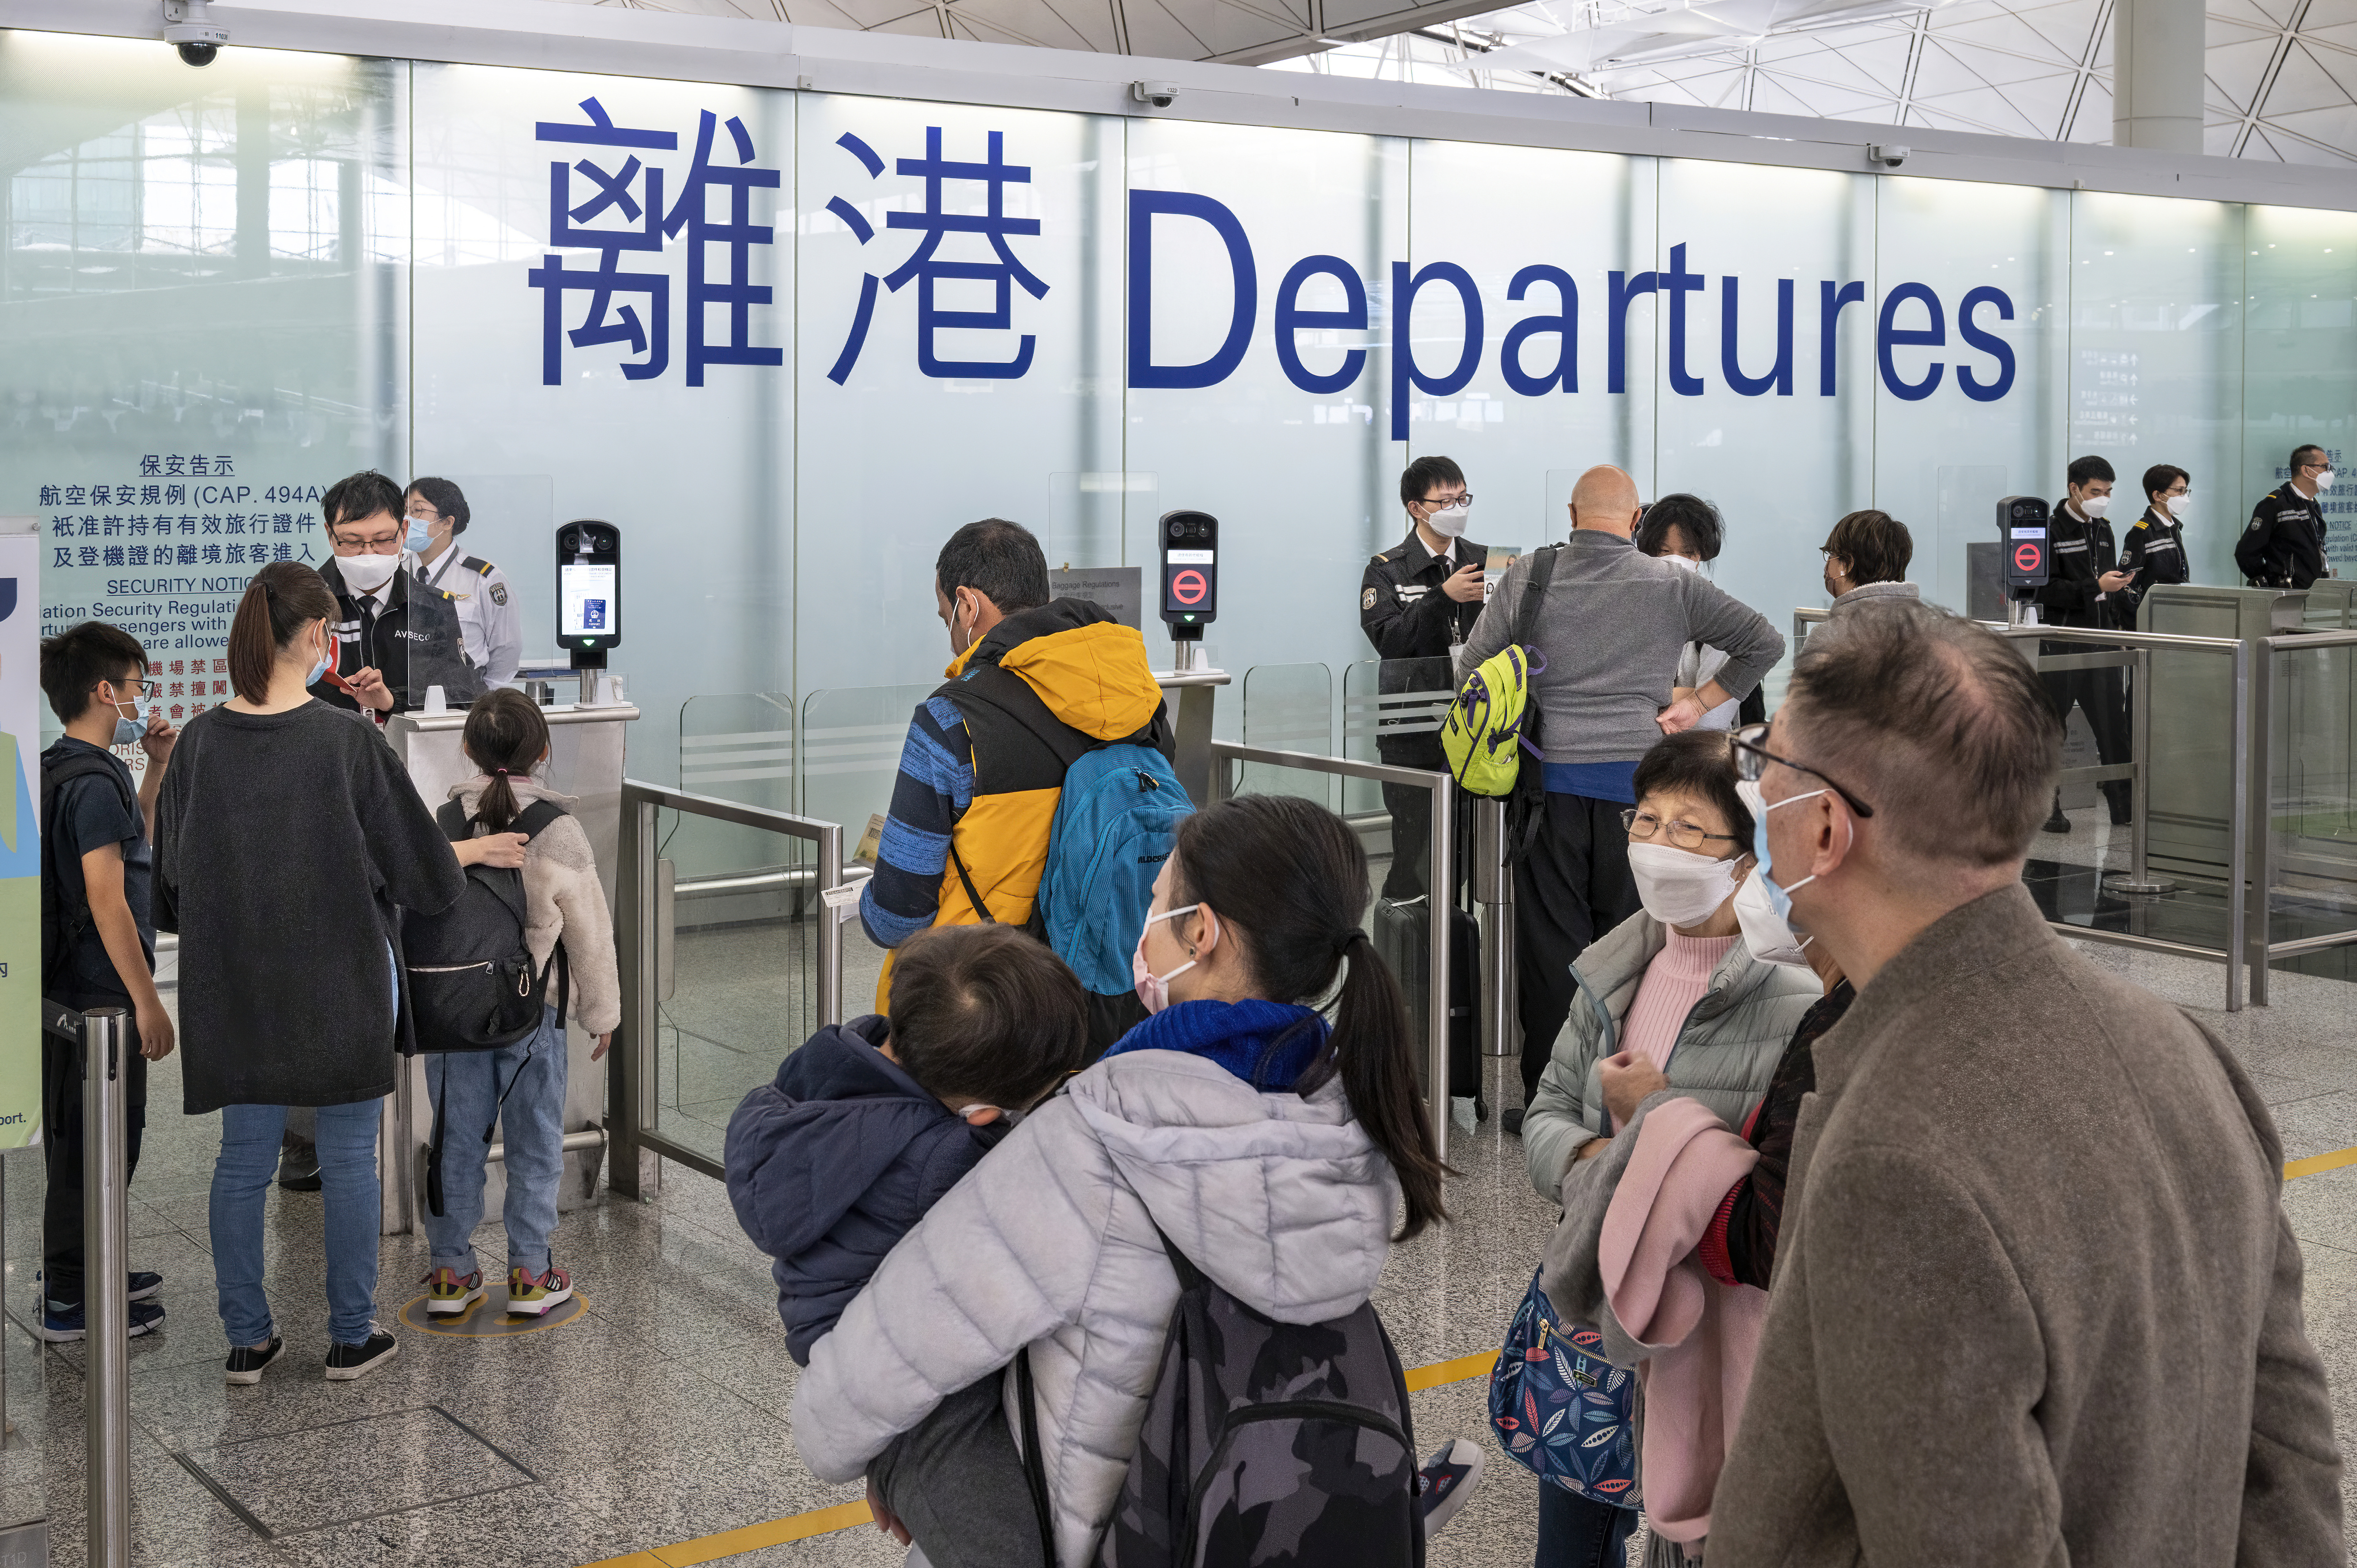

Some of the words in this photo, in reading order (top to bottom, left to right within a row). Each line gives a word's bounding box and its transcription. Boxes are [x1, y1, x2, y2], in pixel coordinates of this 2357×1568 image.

[529, 96, 1051, 386] 離港
[1129, 189, 2016, 441] Departures
[140, 454, 233, 475] 保安告示
[40, 484, 185, 506] 航空保安規例
[194, 486, 257, 508] (CAP.
[53, 543, 315, 567] 及登機證的離境旅客進入
[107, 578, 197, 594] SECURITY
[93, 601, 162, 618] Security
[111, 620, 186, 635] sengers
[191, 616, 226, 631] with
[143, 639, 169, 649] are
[148, 659, 227, 676] 機場禁區
[148, 702, 218, 719] 者會被
